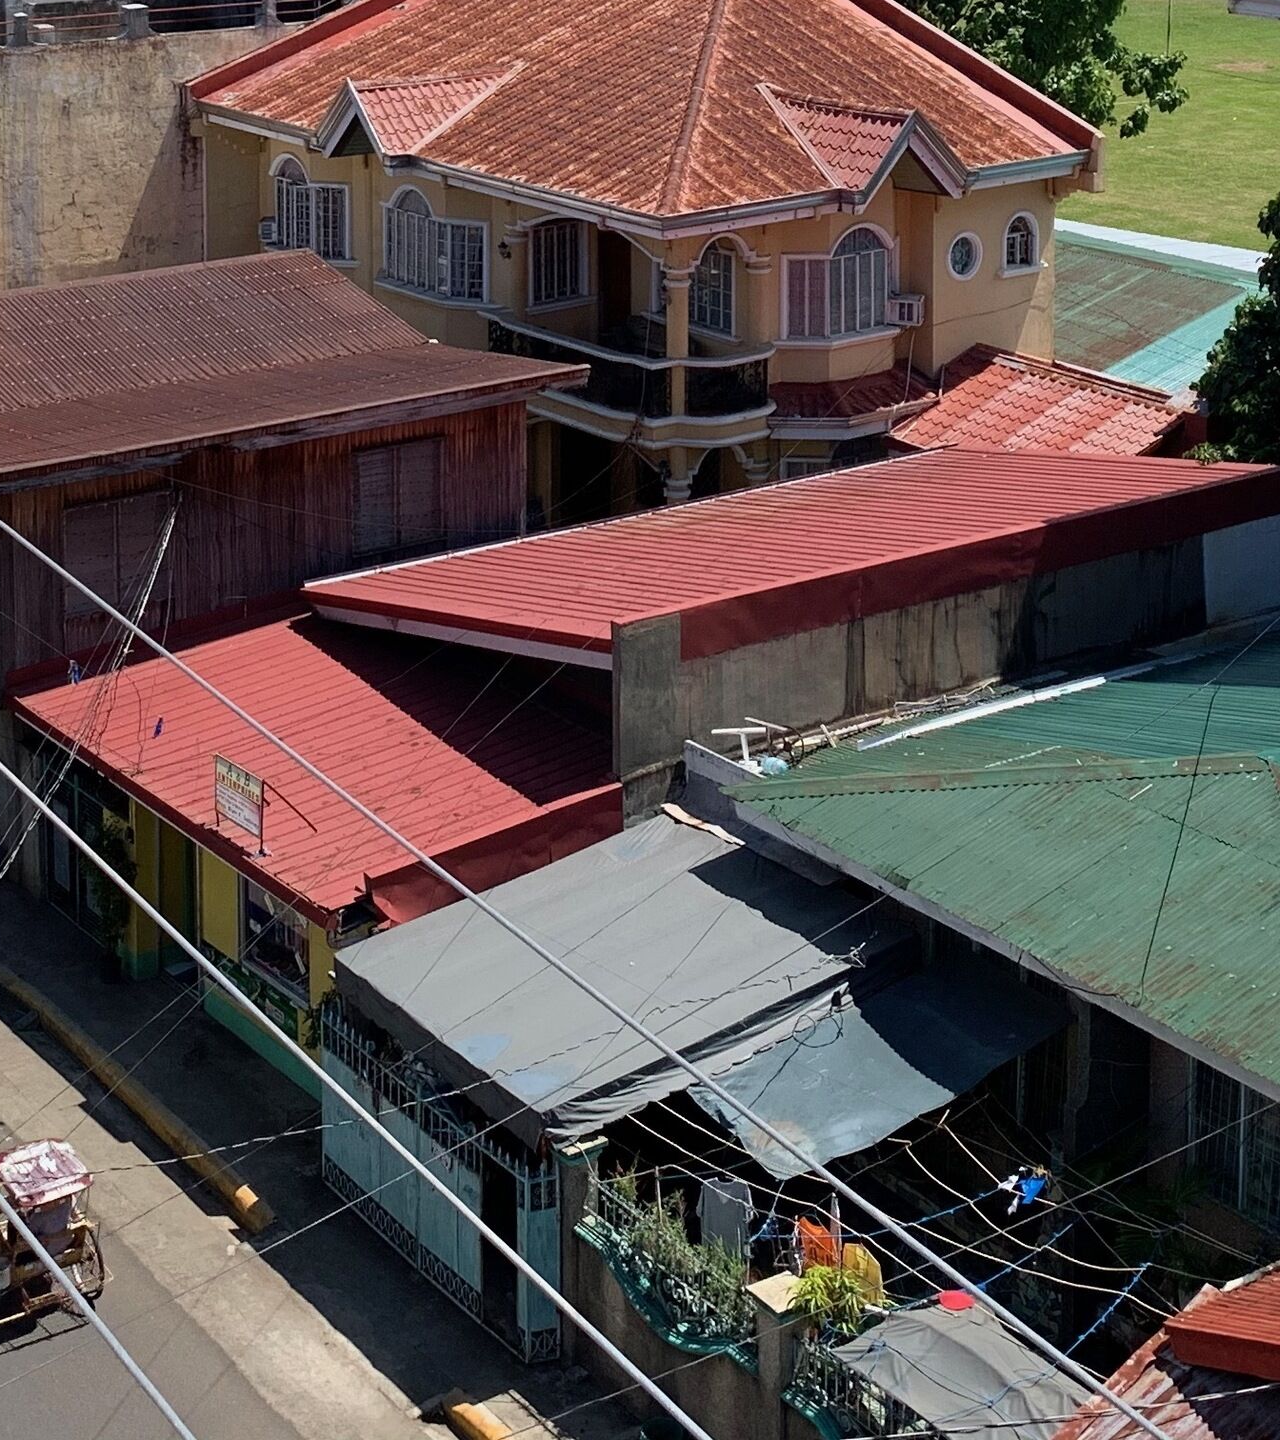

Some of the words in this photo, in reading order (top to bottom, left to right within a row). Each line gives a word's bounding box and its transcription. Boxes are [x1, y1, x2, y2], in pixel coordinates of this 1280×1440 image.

[217, 771, 260, 803] ENTERPRISES
[226, 764, 233, 778] A
[243, 771, 251, 788] B
